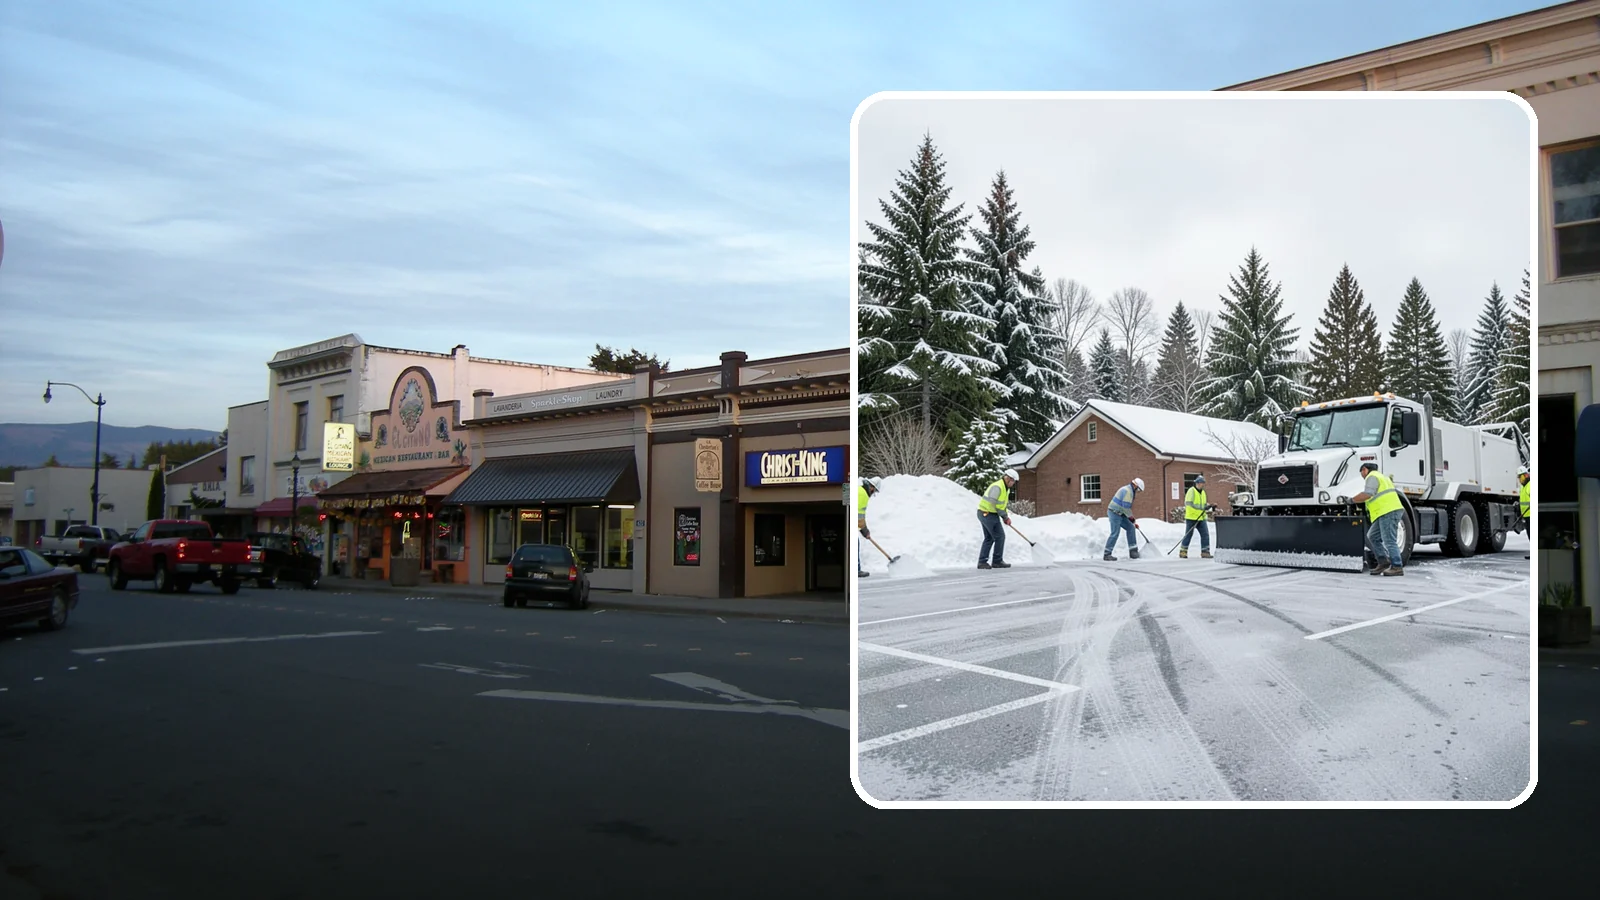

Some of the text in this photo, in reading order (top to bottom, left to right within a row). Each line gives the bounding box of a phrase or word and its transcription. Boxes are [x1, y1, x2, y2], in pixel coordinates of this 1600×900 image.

[493, 389, 624, 412] LAVANDERIA Sparkle Shop LAUNDRY
[373, 455, 396, 464] MEXICAN
[397, 451, 434, 462] RESTAURANT
[438, 450, 450, 459] BAR
[761, 450, 827, 478] CHRIST KING
[710, 481, 721, 489] House
